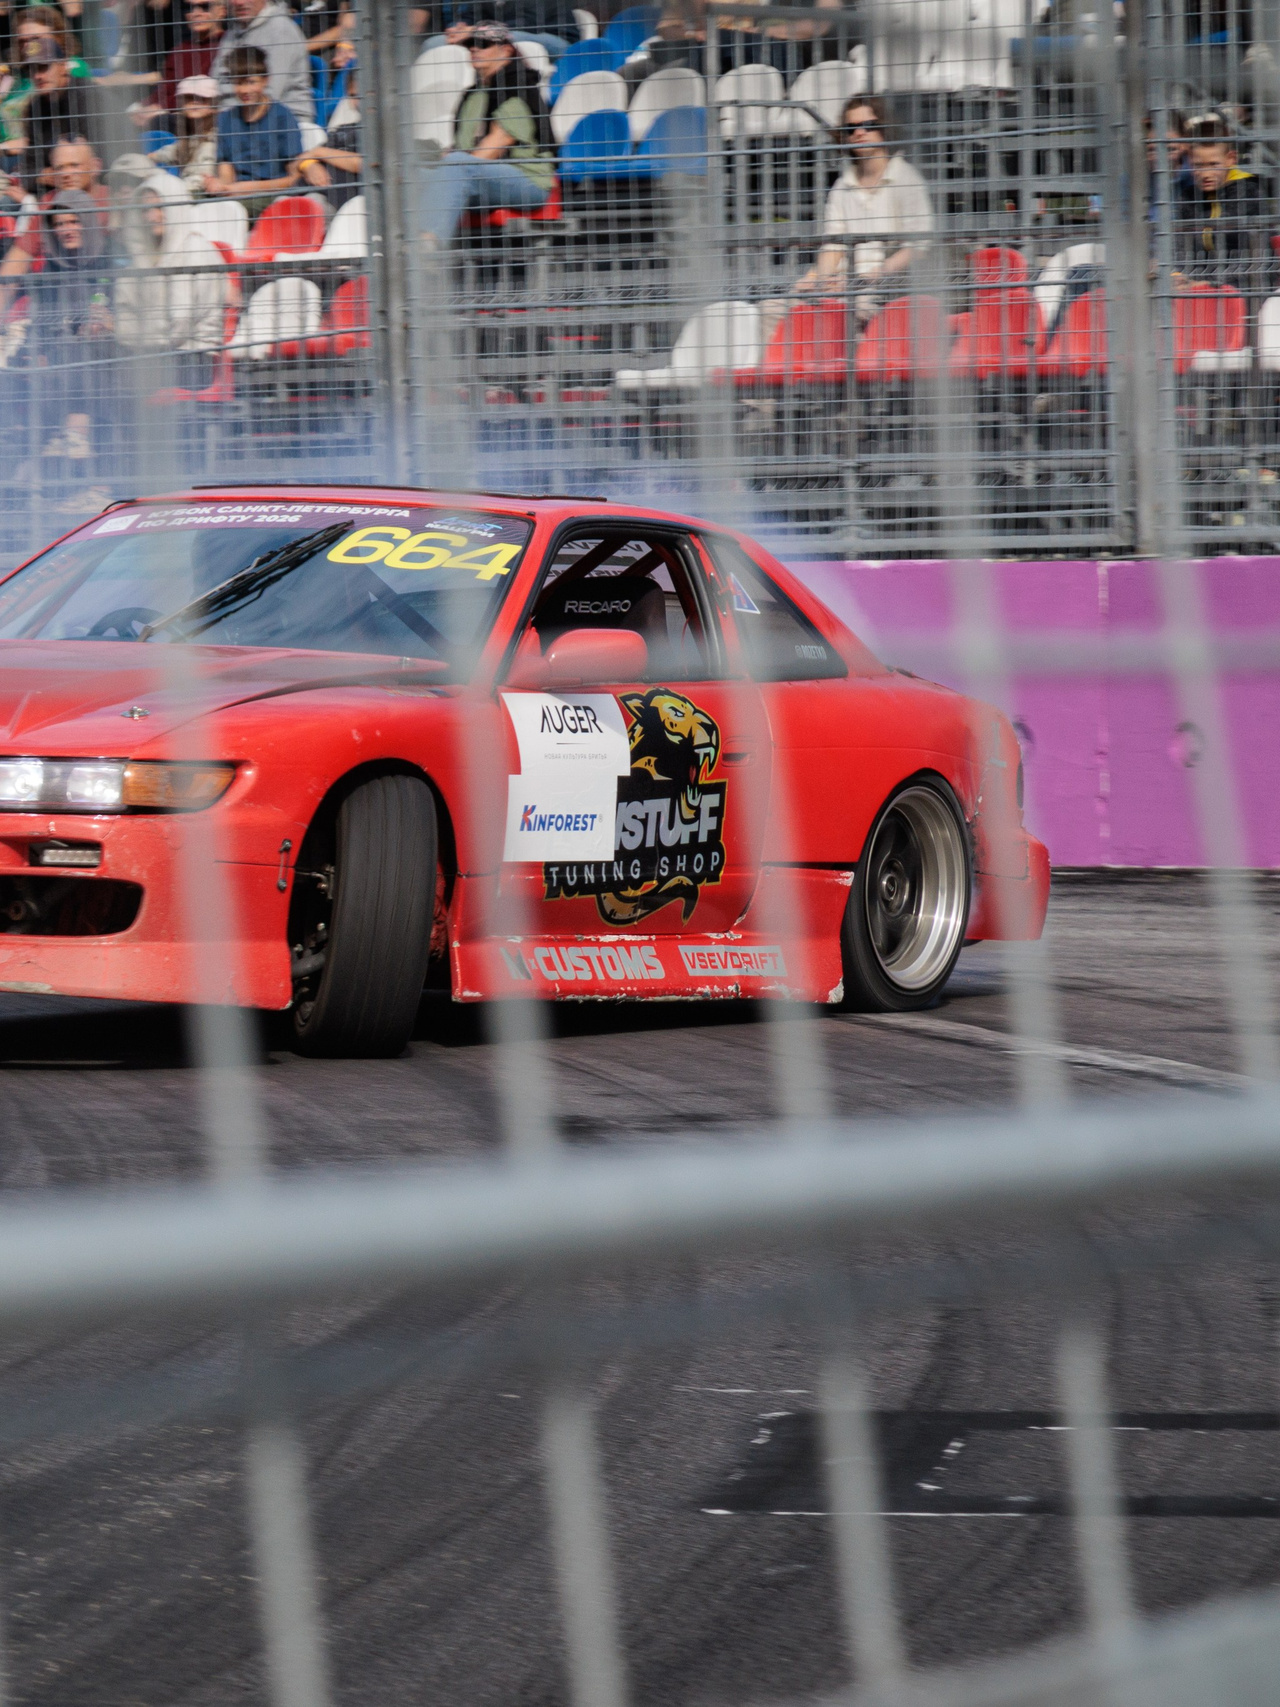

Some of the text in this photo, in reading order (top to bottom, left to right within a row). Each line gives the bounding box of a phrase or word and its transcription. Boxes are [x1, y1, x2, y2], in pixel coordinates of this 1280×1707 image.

[136, 518, 166, 529] ПО
[166, 515, 254, 526] ДРИФТУ
[147, 505, 411, 518] КУБОК САНКТ-ПЕТЕРБУРГА
[326, 526, 522, 581] 664
[564, 599, 631, 613] RECARO
[540, 705, 603, 734] AUGER
[519, 804, 597, 832] KINFOREST
[549, 851, 720, 887] TUNING SHOP
[534, 945, 666, 981] CUSTOMS
[683, 951, 781, 972] VSEVDRIFT
